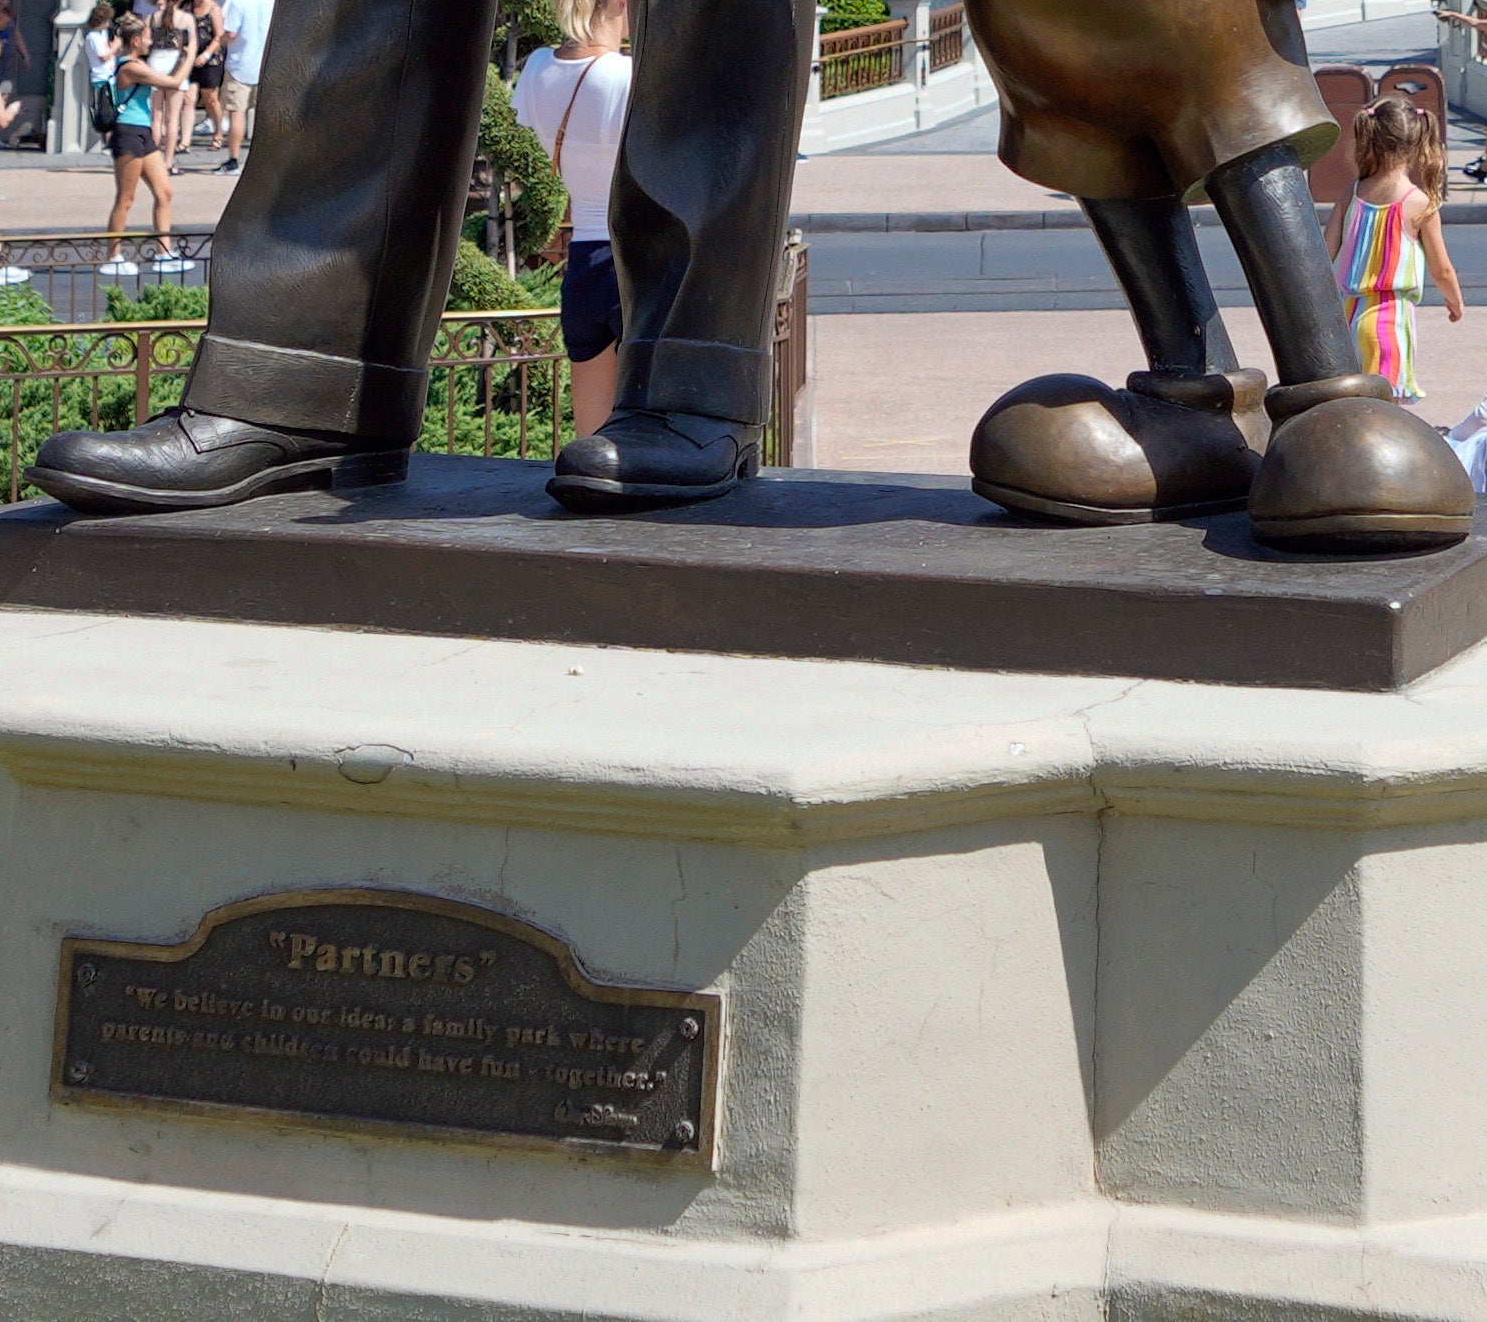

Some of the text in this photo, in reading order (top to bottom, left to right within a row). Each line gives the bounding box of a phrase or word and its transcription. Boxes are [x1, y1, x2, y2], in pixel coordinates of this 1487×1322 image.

[100, 1021, 188, 1046] parents
[192, 1031, 235, 1052] and
[417, 1048, 474, 1074] have
[480, 1060, 521, 1079] fun
[174, 989, 254, 1018] believe
[263, 999, 285, 1022] in
[292, 1006, 331, 1025] our
[402, 1017, 414, 1034] a
[422, 1014, 498, 1046] family
[505, 1024, 562, 1049] park
[568, 1032, 645, 1054] where
